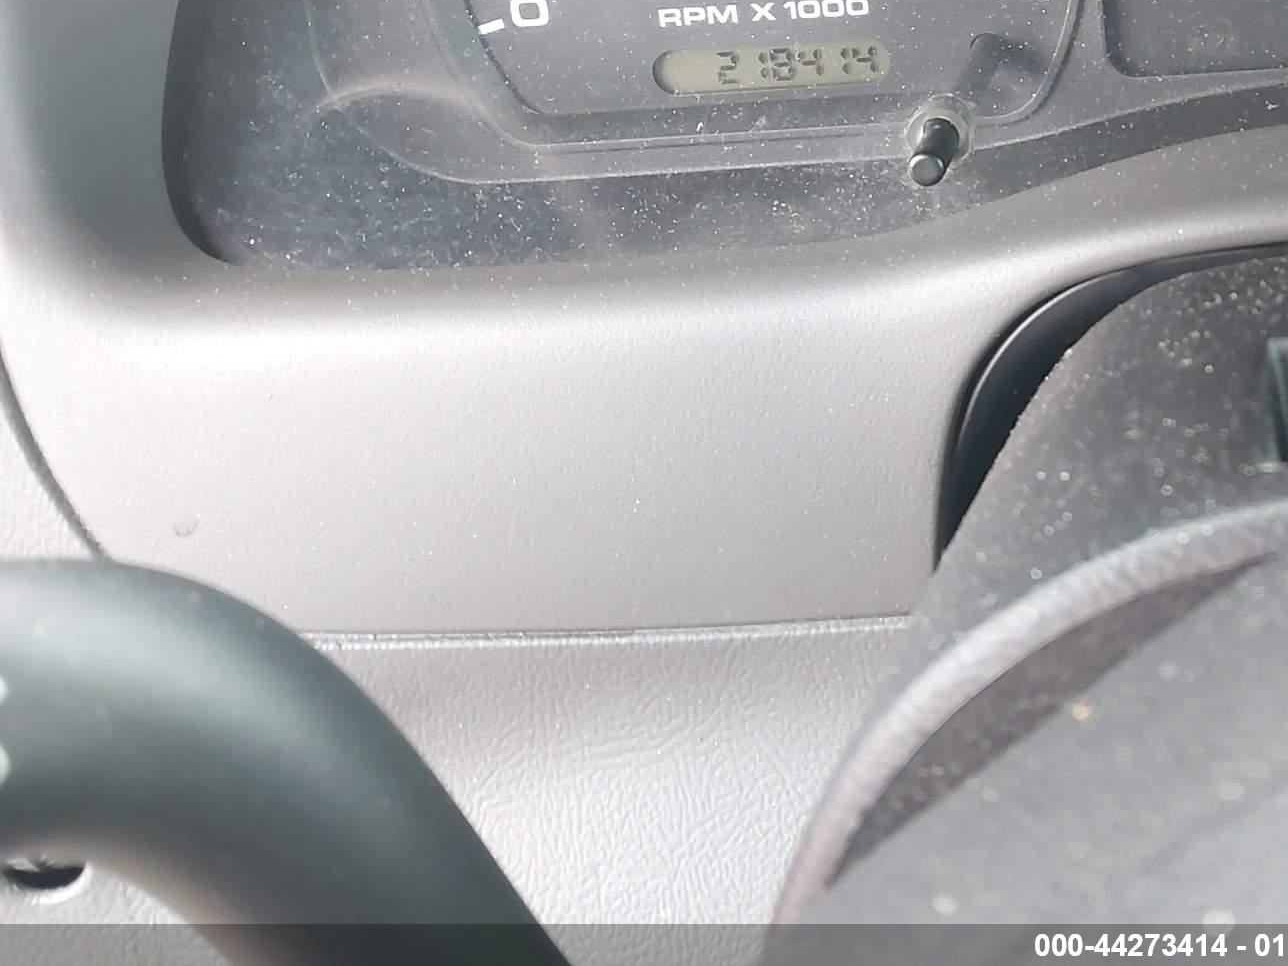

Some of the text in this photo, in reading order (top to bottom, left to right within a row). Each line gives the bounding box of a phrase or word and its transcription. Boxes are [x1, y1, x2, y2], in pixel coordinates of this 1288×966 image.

[657, 5, 739, 28] RPM
[750, 2, 777, 24] X
[716, 46, 879, 84] 218414
